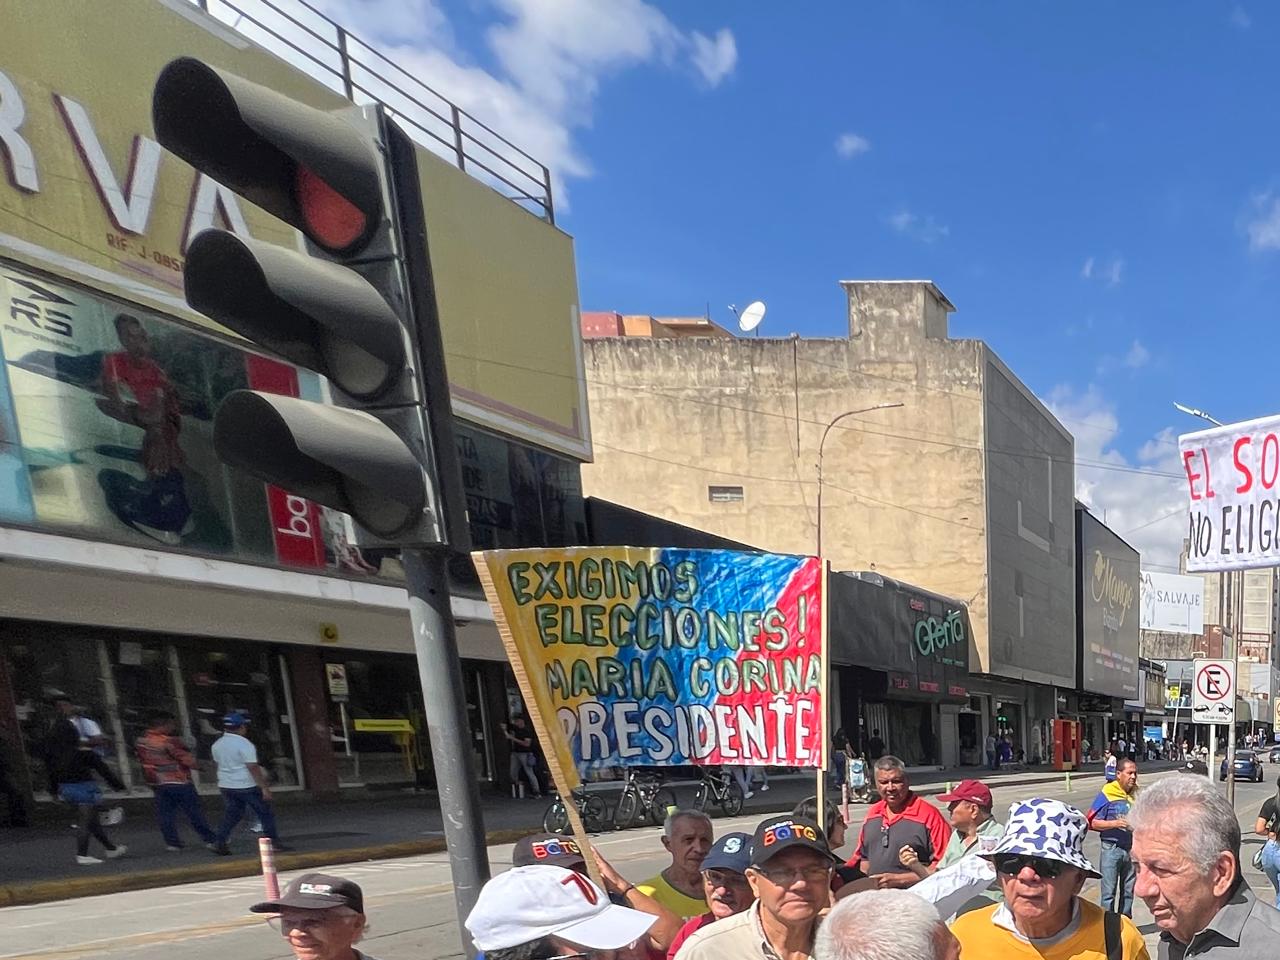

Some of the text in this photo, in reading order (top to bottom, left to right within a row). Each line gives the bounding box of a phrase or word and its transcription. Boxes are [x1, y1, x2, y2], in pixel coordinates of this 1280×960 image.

[1183, 448, 1215, 501] EL
[1187, 511, 1213, 558] NO
[507, 558, 699, 605] EXIGIMOS
[1157, 590, 1201, 607] SALVAJE
[545, 654, 822, 704] MARIA CORINA
[1206, 671, 1221, 695] E
[556, 691, 814, 762] PRESIDENTE
